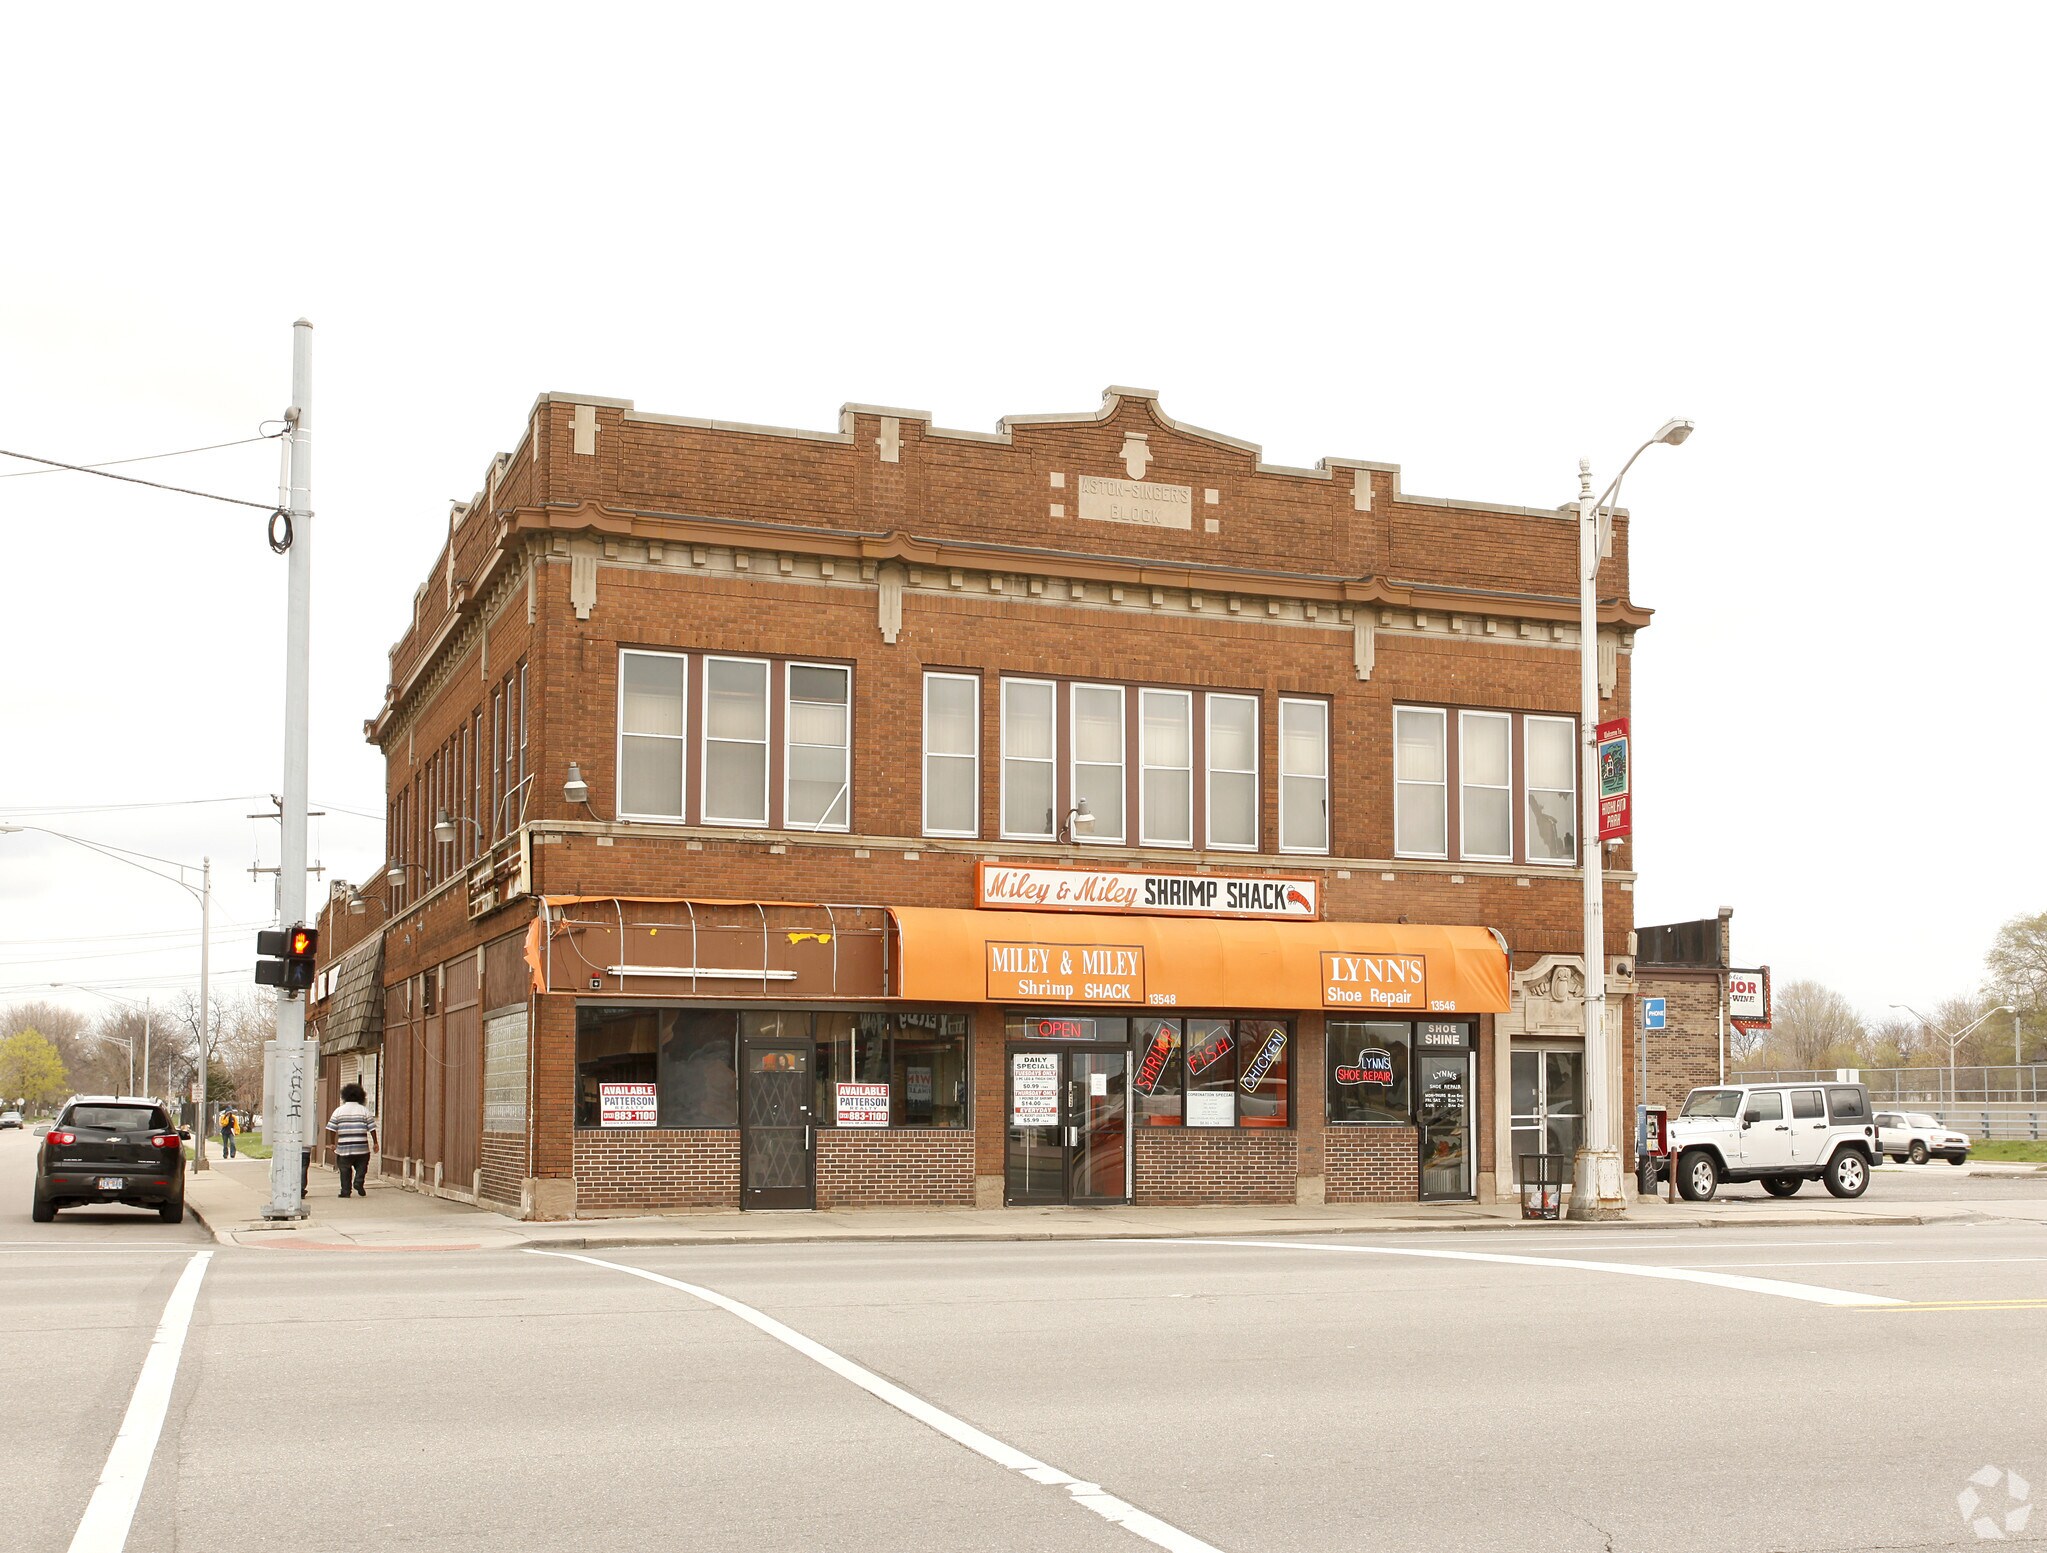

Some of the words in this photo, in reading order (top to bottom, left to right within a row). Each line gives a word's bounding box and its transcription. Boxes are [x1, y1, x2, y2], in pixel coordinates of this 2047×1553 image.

[1081, 479, 1189, 504] ASTON-SINGER'S
[1111, 505, 1161, 524] BLOCK
[1602, 798, 1626, 816] HIGHLAND
[1607, 813, 1621, 829] PARK
[987, 871, 1049, 904] Miley
[1056, 881, 1071, 901] &
[1074, 875, 1138, 907] Miley
[1144, 878, 1218, 907] SHRIMP
[1227, 882, 1287, 910] SHACK
[992, 947, 1050, 974] MILEY
[1060, 950, 1073, 975] &
[1082, 949, 1138, 976] MILEY
[1330, 957, 1423, 984] LYNN'S
[1018, 979, 1074, 1000] Shrimp
[1084, 983, 1131, 999] SHACK
[1327, 987, 1362, 1002] Shoe
[1370, 988, 1412, 1007] Repair
[1149, 994, 1176, 1005] 13548
[1431, 1000, 1455, 1011] 13546
[1039, 1021, 1081, 1037] OPEN
[1428, 1024, 1457, 1033] SHOE
[1425, 1034, 1460, 1045] SHINE
[1137, 1028, 1172, 1091] SHRIMP
[1188, 1037, 1229, 1073] FISH
[1243, 1033, 1285, 1089] CHICKEN
[1361, 1057, 1390, 1069] LYNN'S
[1338, 1069, 1361, 1081] SHOE
[1363, 1070, 1391, 1082] REPAIR
[604, 1086, 654, 1095] AVAILABLE
[840, 1086, 886, 1096] AVAILABLE
[604, 1097, 654, 1105] PATTERSON
[840, 1098, 887, 1106] PATTERSON
[614, 1111, 655, 1120] 883-1100
[849, 1111, 887, 1120] 883-1100
